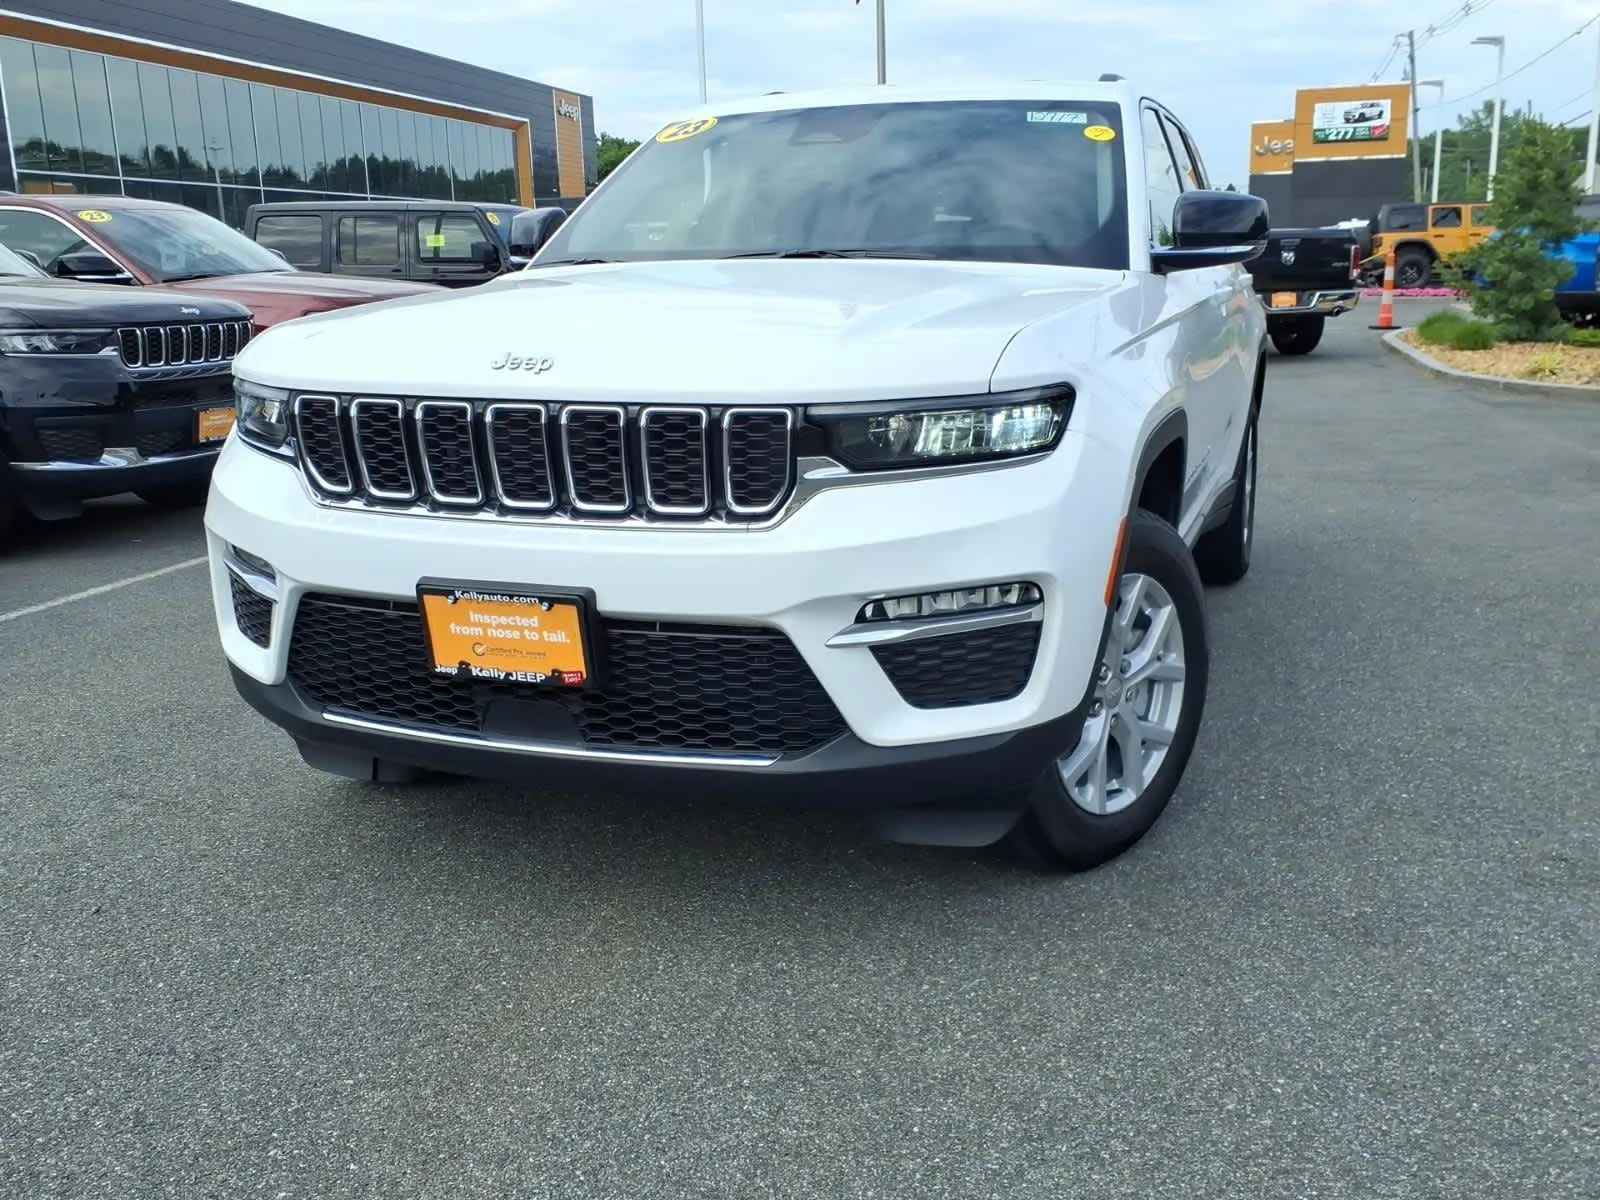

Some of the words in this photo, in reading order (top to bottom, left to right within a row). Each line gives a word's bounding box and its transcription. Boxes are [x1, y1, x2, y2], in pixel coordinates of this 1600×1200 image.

[559, 98, 579, 121] Jeep
[1325, 127, 1353, 140] $277
[1256, 136, 1294, 155] Jee
[489, 352, 554, 375] Jeep
[454, 591, 539, 604] Kellyauto.com
[469, 611, 539, 627] Inspected
[449, 623, 483, 636] from
[488, 628, 520, 639] nose
[524, 629, 539, 641] to
[543, 631, 570, 643] tail.
[435, 664, 458, 675] Jeep
[471, 667, 506, 680] Kelly
[509, 672, 546, 683] JEEP
